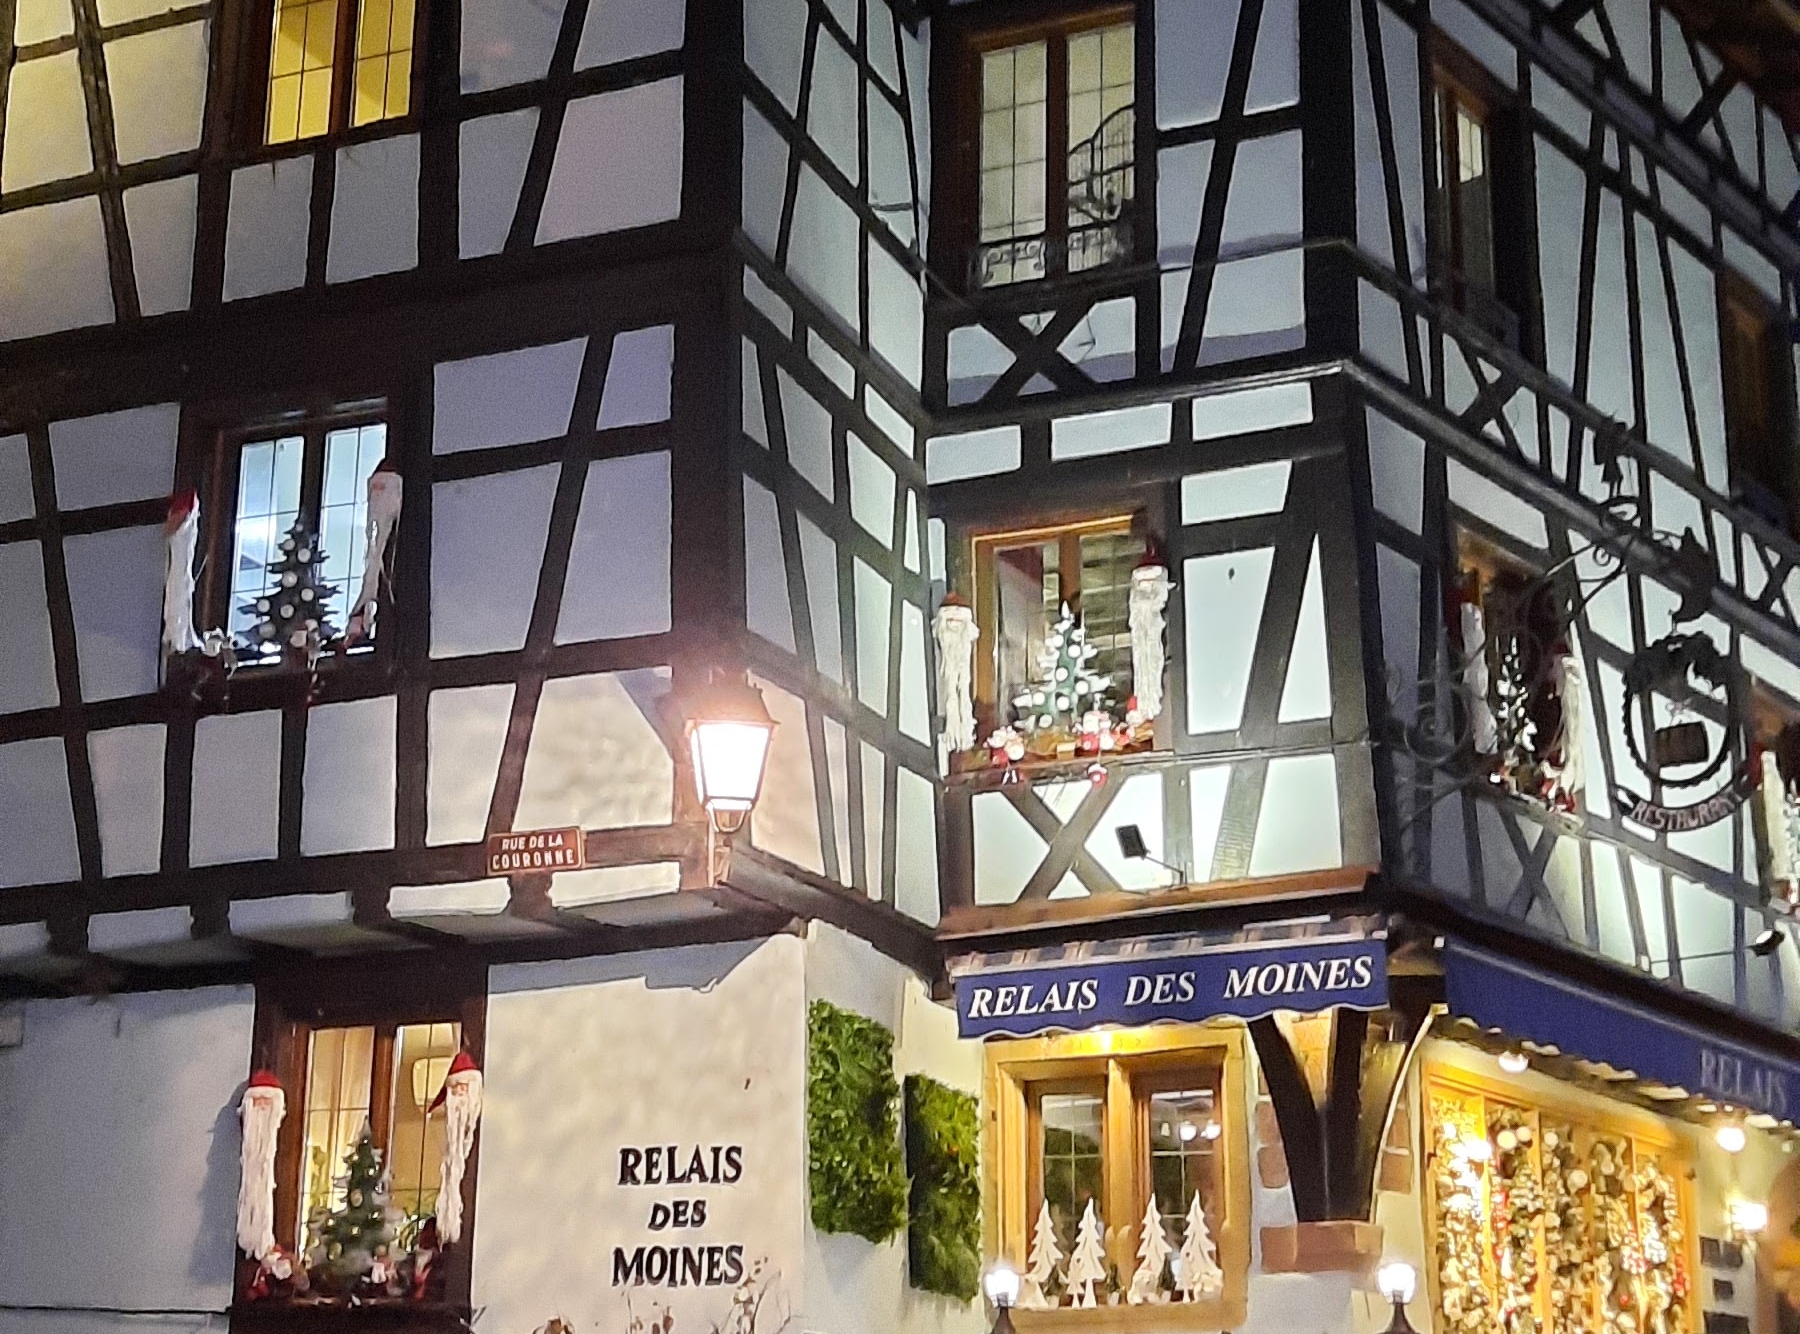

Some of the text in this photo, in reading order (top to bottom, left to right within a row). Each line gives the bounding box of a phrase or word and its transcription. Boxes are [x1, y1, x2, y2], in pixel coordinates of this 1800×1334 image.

[492, 849, 575, 870] COURONNE
[502, 834, 563, 851] RUE DE LA
[967, 955, 1373, 1019] RELAIS DES MOINES
[1701, 1049, 1787, 1115] RELAIS
[618, 1144, 743, 1186] RELAIS
[648, 1200, 707, 1230] DES
[612, 1244, 744, 1287] MOINES
